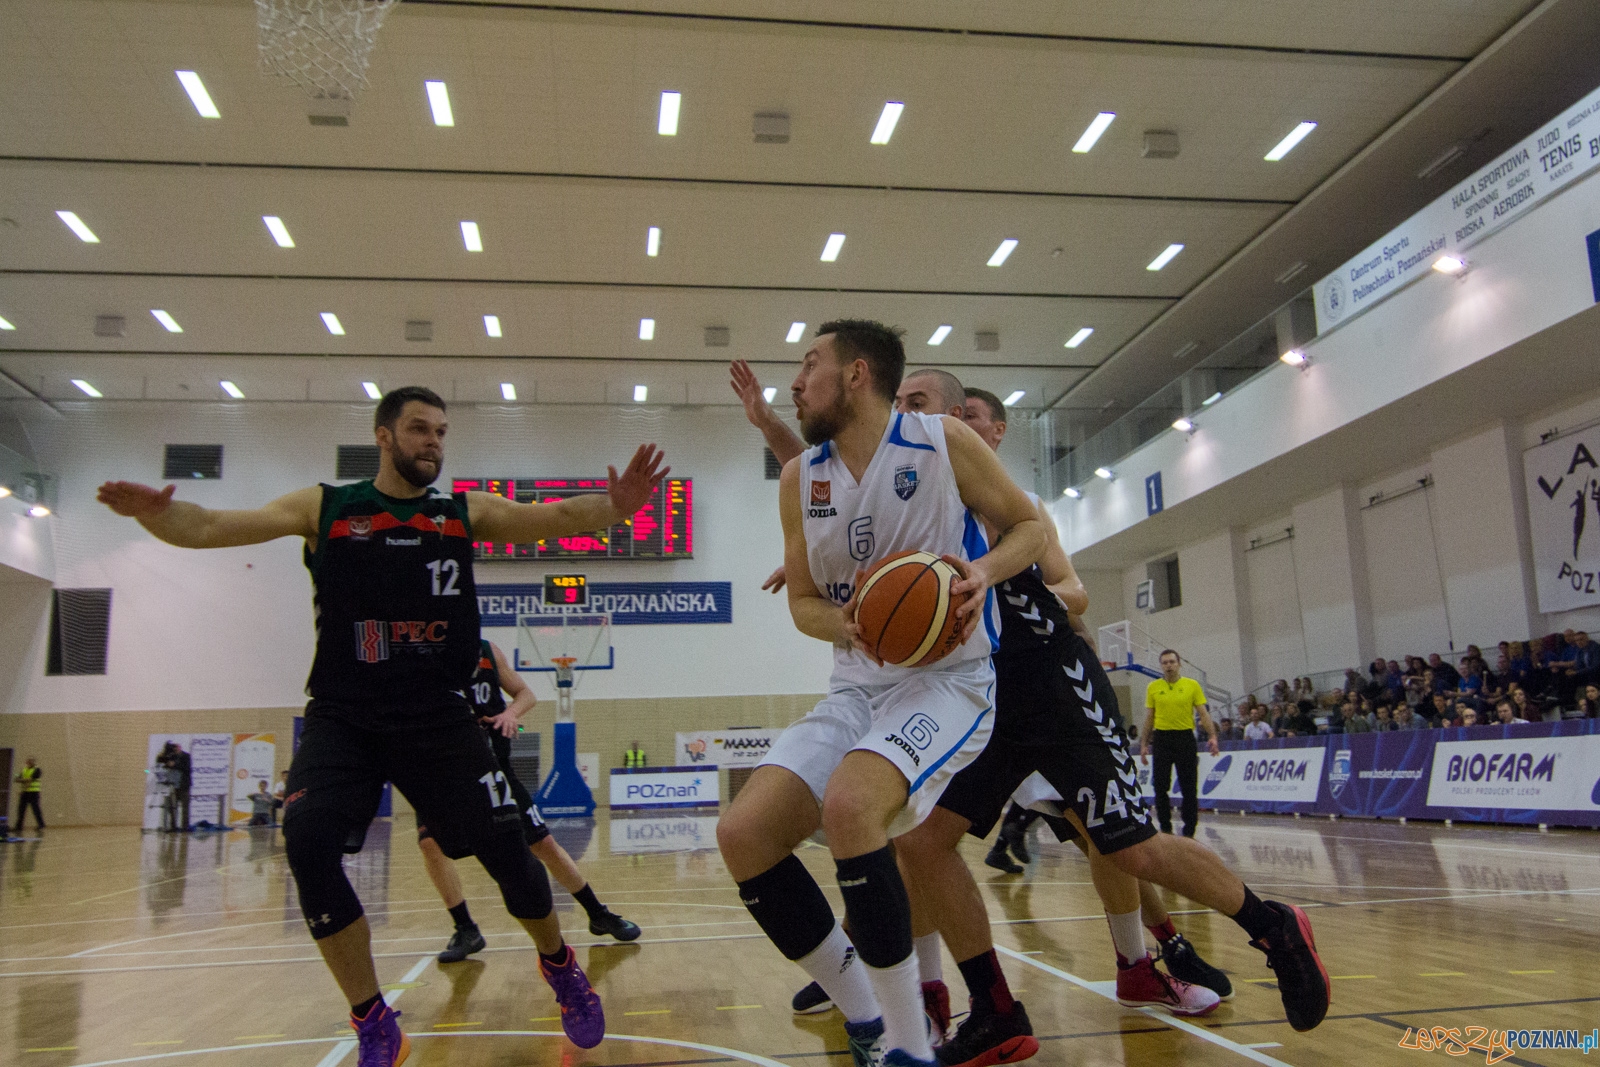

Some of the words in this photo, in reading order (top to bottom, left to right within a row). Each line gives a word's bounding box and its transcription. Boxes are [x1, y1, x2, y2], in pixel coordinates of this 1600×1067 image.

[1537, 127, 1560, 152] JUDO
[1540, 133, 1582, 173] TENIS
[1452, 185, 1477, 210] HALA
[1478, 148, 1530, 192] SPORTOWA
[1455, 216, 1485, 242] BOISKA
[1493, 181, 1535, 219] AEROBIK
[1350, 256, 1382, 282] Centrum
[1383, 236, 1409, 261] Sportu
[1352, 266, 1395, 303] Politechniki
[1397, 233, 1447, 274] Poznańskiej
[386, 536, 422, 546] hummel
[848, 515, 875, 562] 6
[426, 559, 461, 596] 12
[1558, 561, 1600, 593] POZ
[590, 590, 717, 614] POZNAŃSKA
[391, 620, 449, 642] PEC
[471, 682, 491, 705] 10
[723, 738, 771, 749] MAXXX
[901, 712, 940, 750] 6
[1244, 759, 1308, 781] BIOFARM
[1447, 753, 1556, 782] BIOFARM
[478, 770, 517, 808] 12
[1077, 779, 1128, 828] 24
[1451, 787, 1474, 795] POLSKI
[1476, 786, 1515, 796] PRODUCENT
[526, 804, 545, 827] 10
